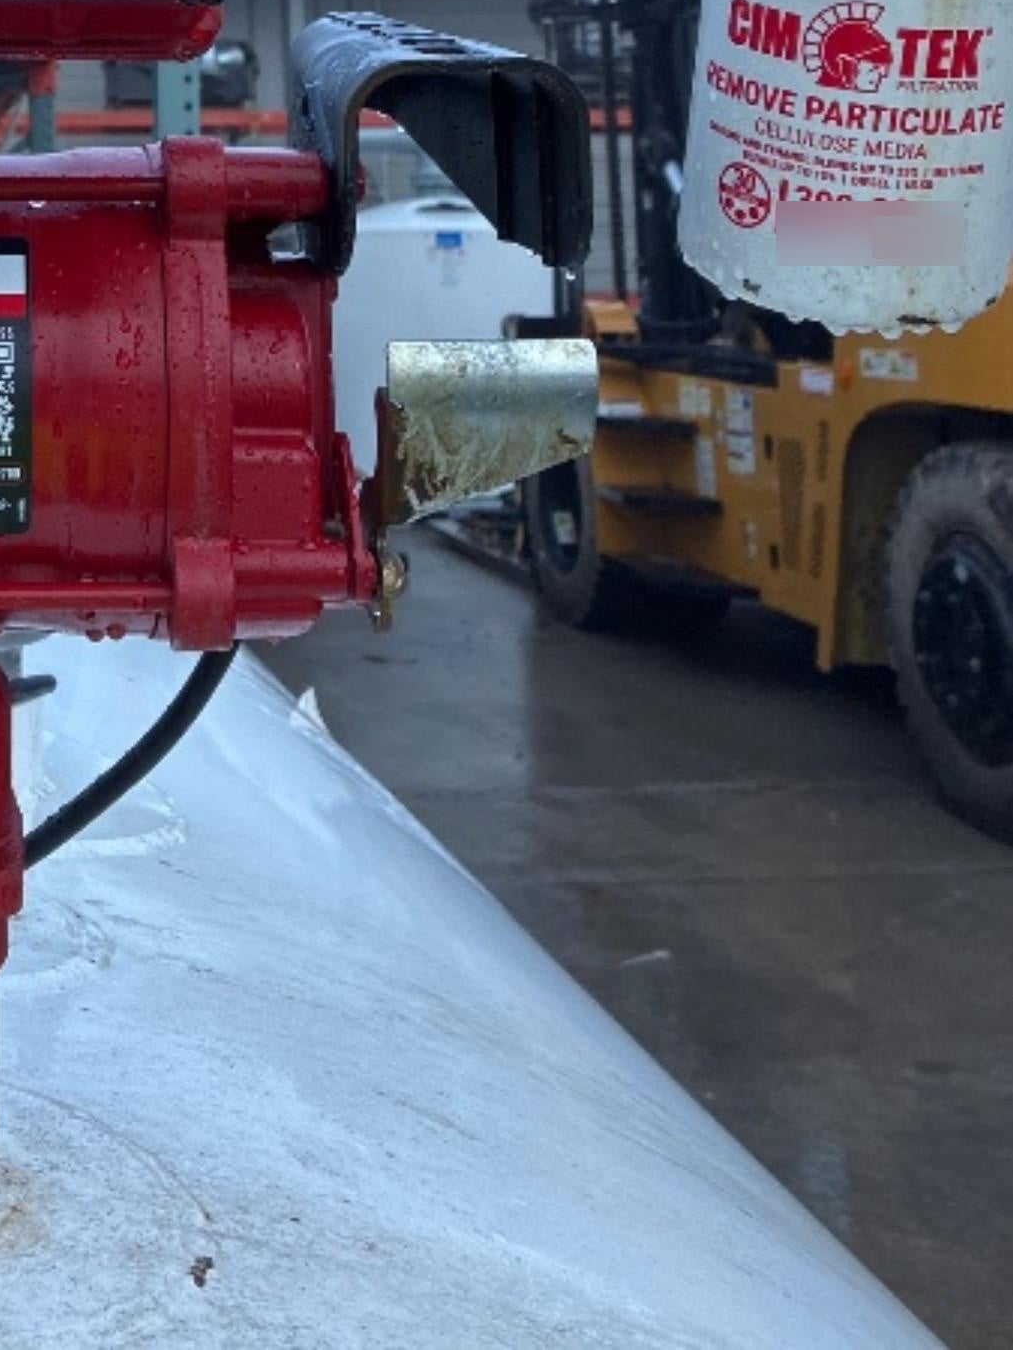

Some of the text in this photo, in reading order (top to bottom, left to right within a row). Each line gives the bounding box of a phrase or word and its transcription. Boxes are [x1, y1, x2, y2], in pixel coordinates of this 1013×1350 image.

[896, 28, 985, 78] TEK
[706, 59, 1006, 136] REMOVE PARTICULATE
[863, 139, 928, 160] MEDIA
